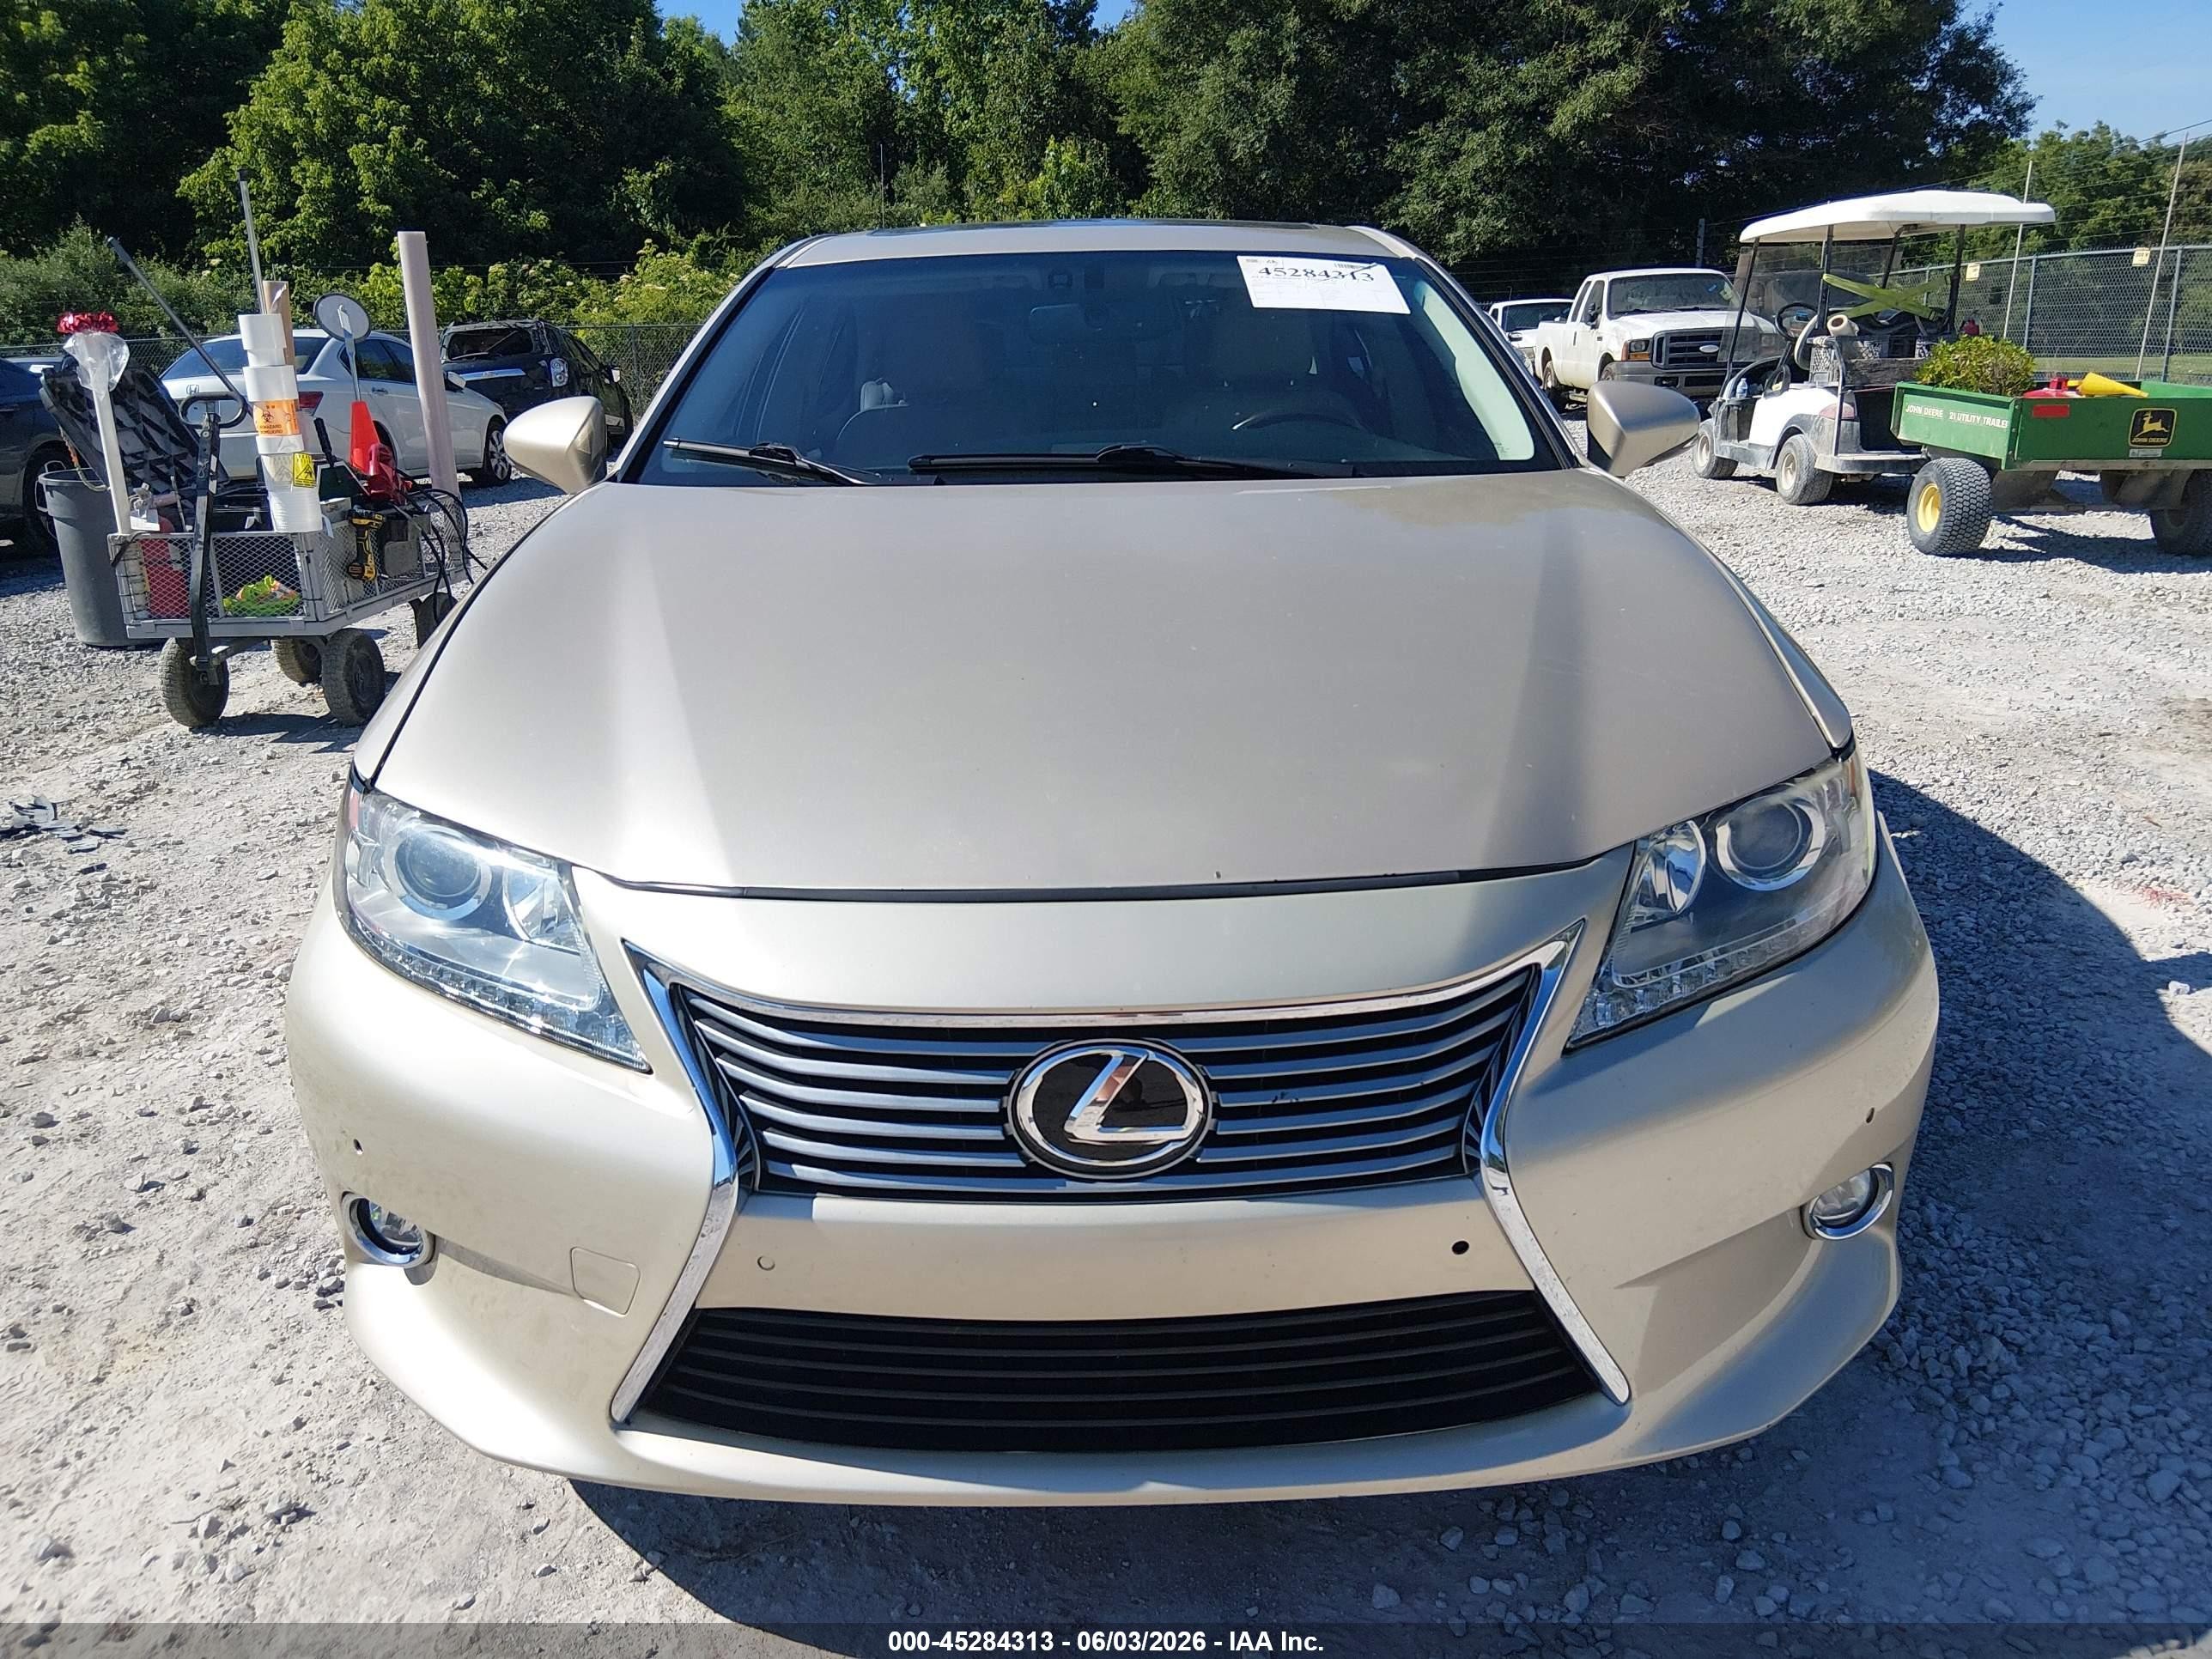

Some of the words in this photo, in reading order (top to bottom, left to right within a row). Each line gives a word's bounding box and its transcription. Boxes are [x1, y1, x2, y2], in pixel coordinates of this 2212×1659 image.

[1258, 266, 1375, 283] 45284313
[1905, 404, 1923, 415] JOHN
[1923, 407, 1944, 418] DEERE
[1957, 412, 1982, 425] UTILITY
